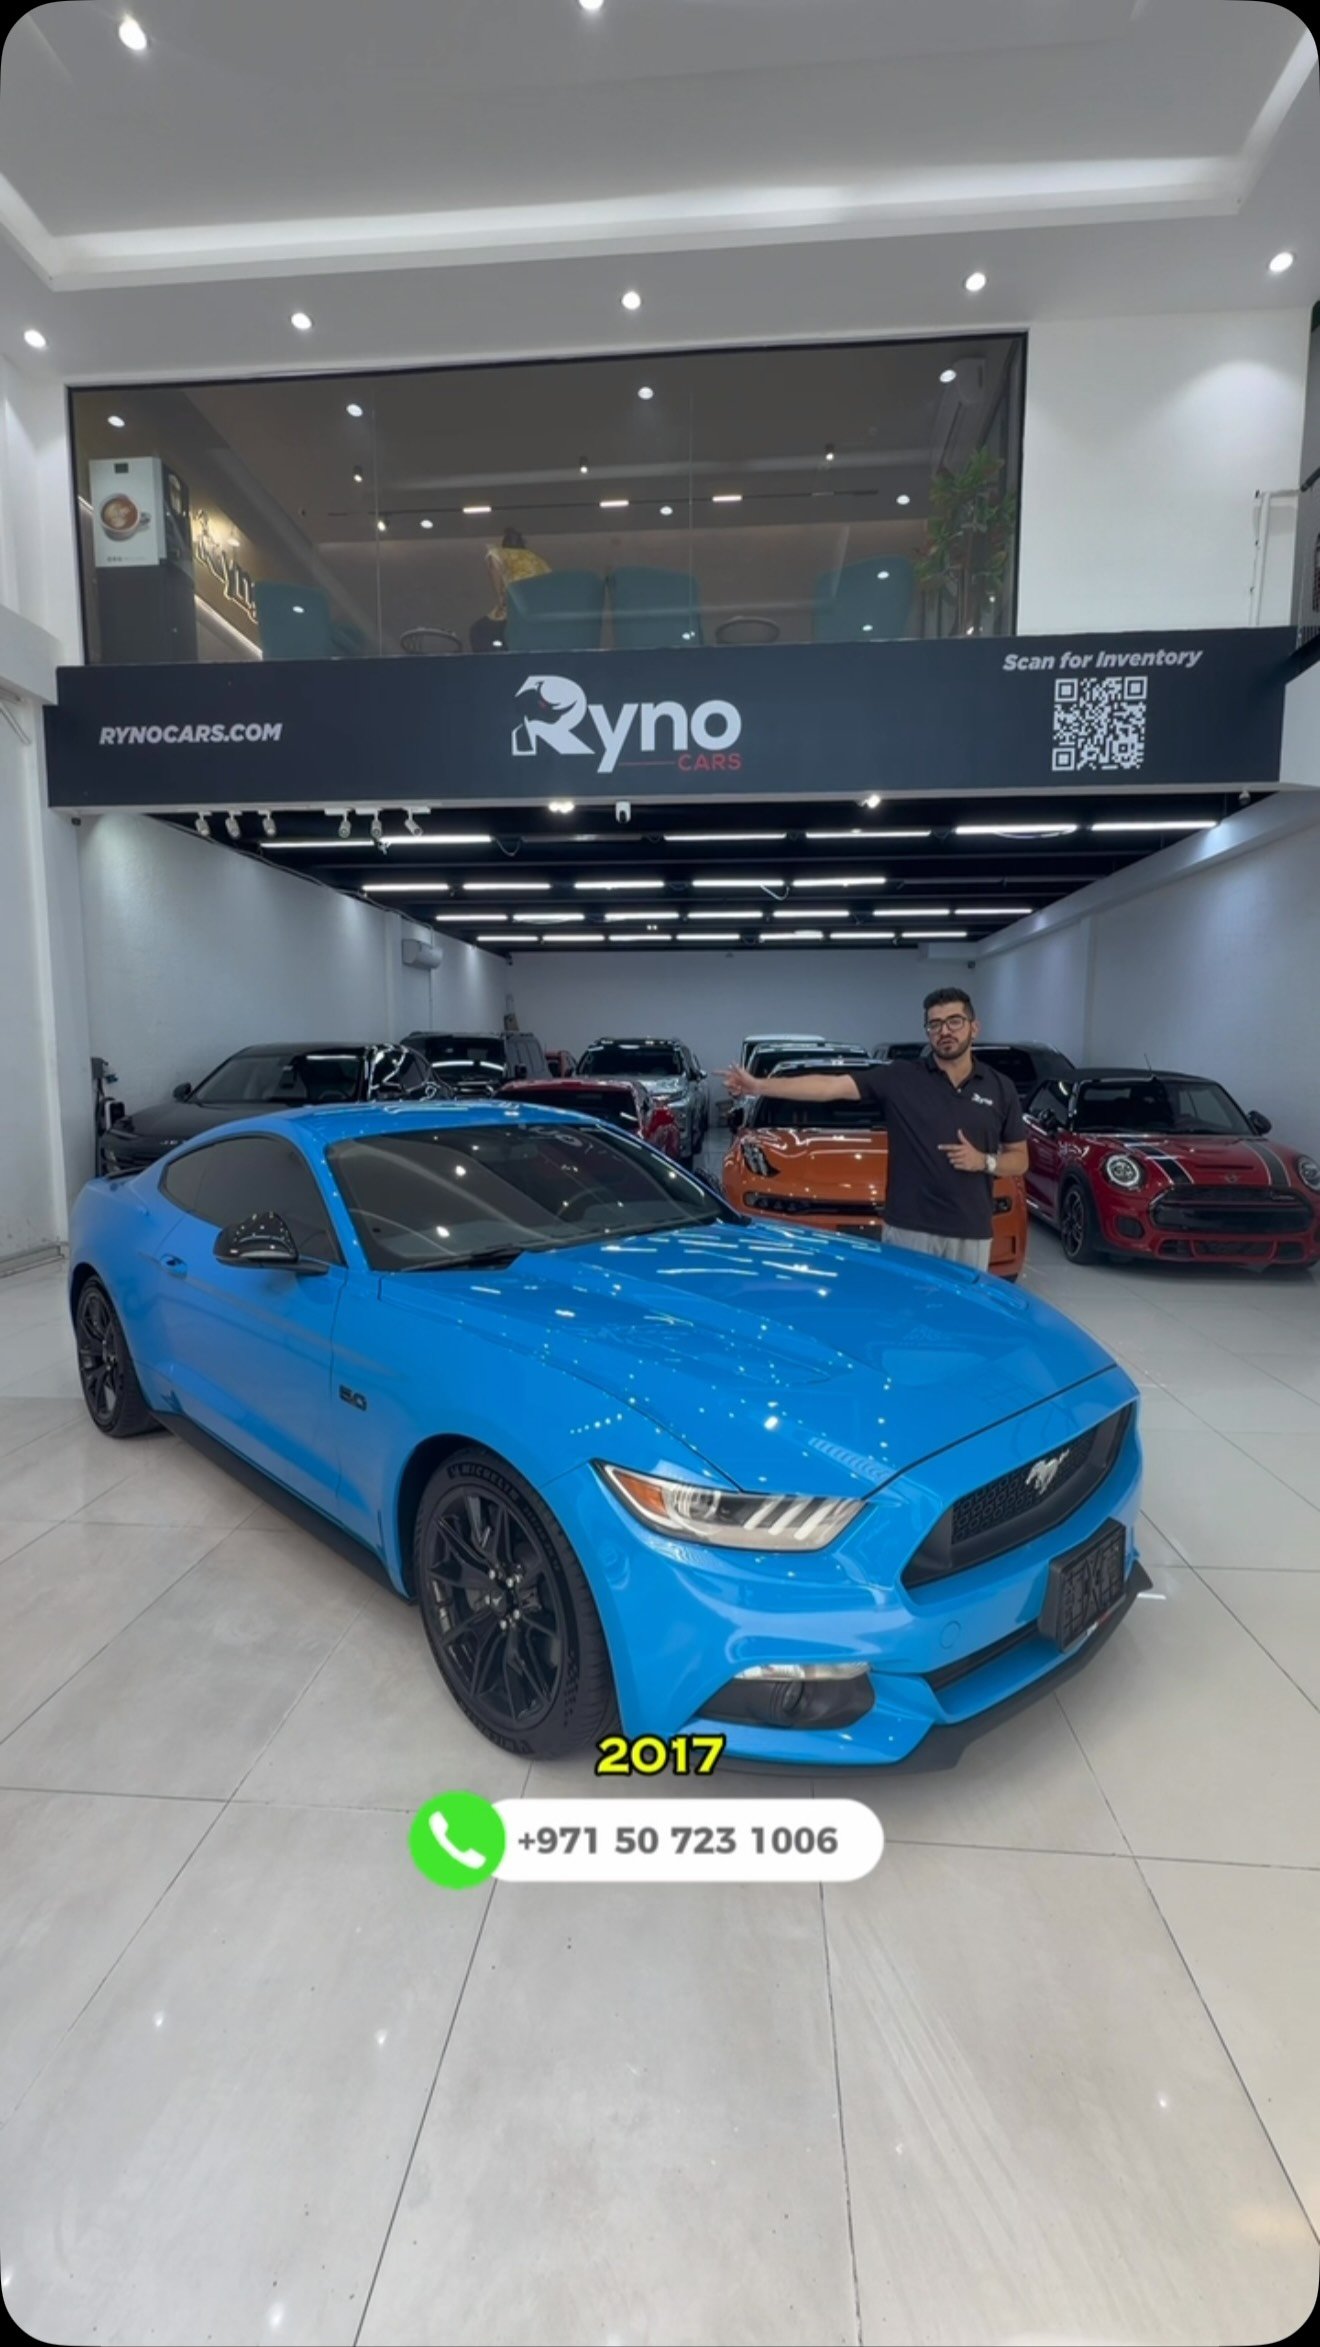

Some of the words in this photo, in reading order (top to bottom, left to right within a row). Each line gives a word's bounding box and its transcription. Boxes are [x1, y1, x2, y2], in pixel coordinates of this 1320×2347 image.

[1002, 653, 1055, 671] Scan
[1059, 651, 1093, 669] for
[1095, 648, 1203, 669] Inventory
[98, 723, 283, 745] RYNOCARS.COM
[512, 674, 742, 774] Ryno
[676, 752, 742, 772] CARS
